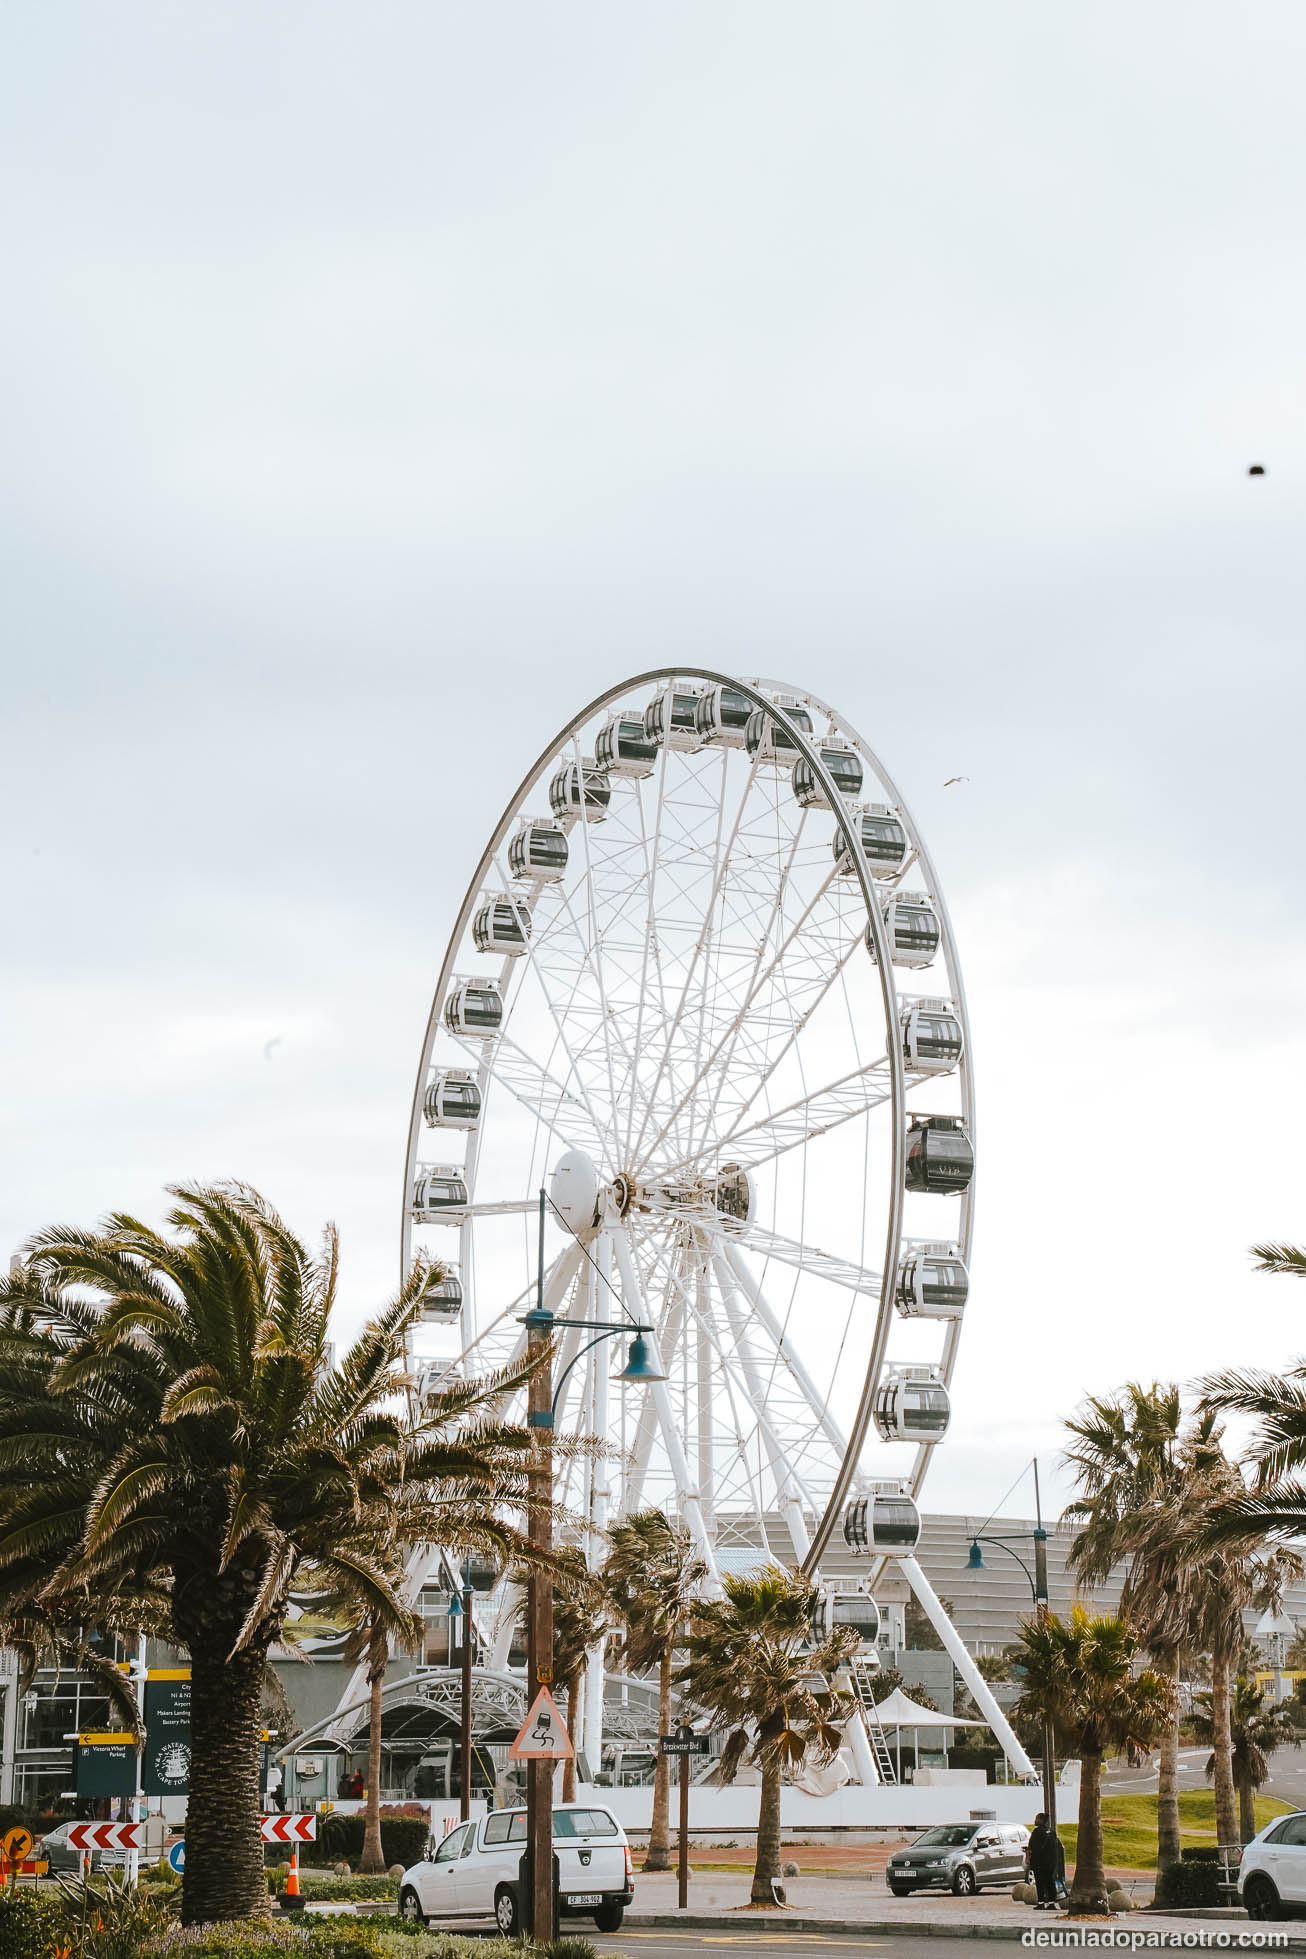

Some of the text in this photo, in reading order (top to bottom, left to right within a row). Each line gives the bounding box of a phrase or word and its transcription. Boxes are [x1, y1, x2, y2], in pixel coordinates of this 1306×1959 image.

[939, 1166, 961, 1176] VIP
[663, 1741, 700, 1751] Breakwater Blvd
[157, 1772, 172, 1786] CAPE
